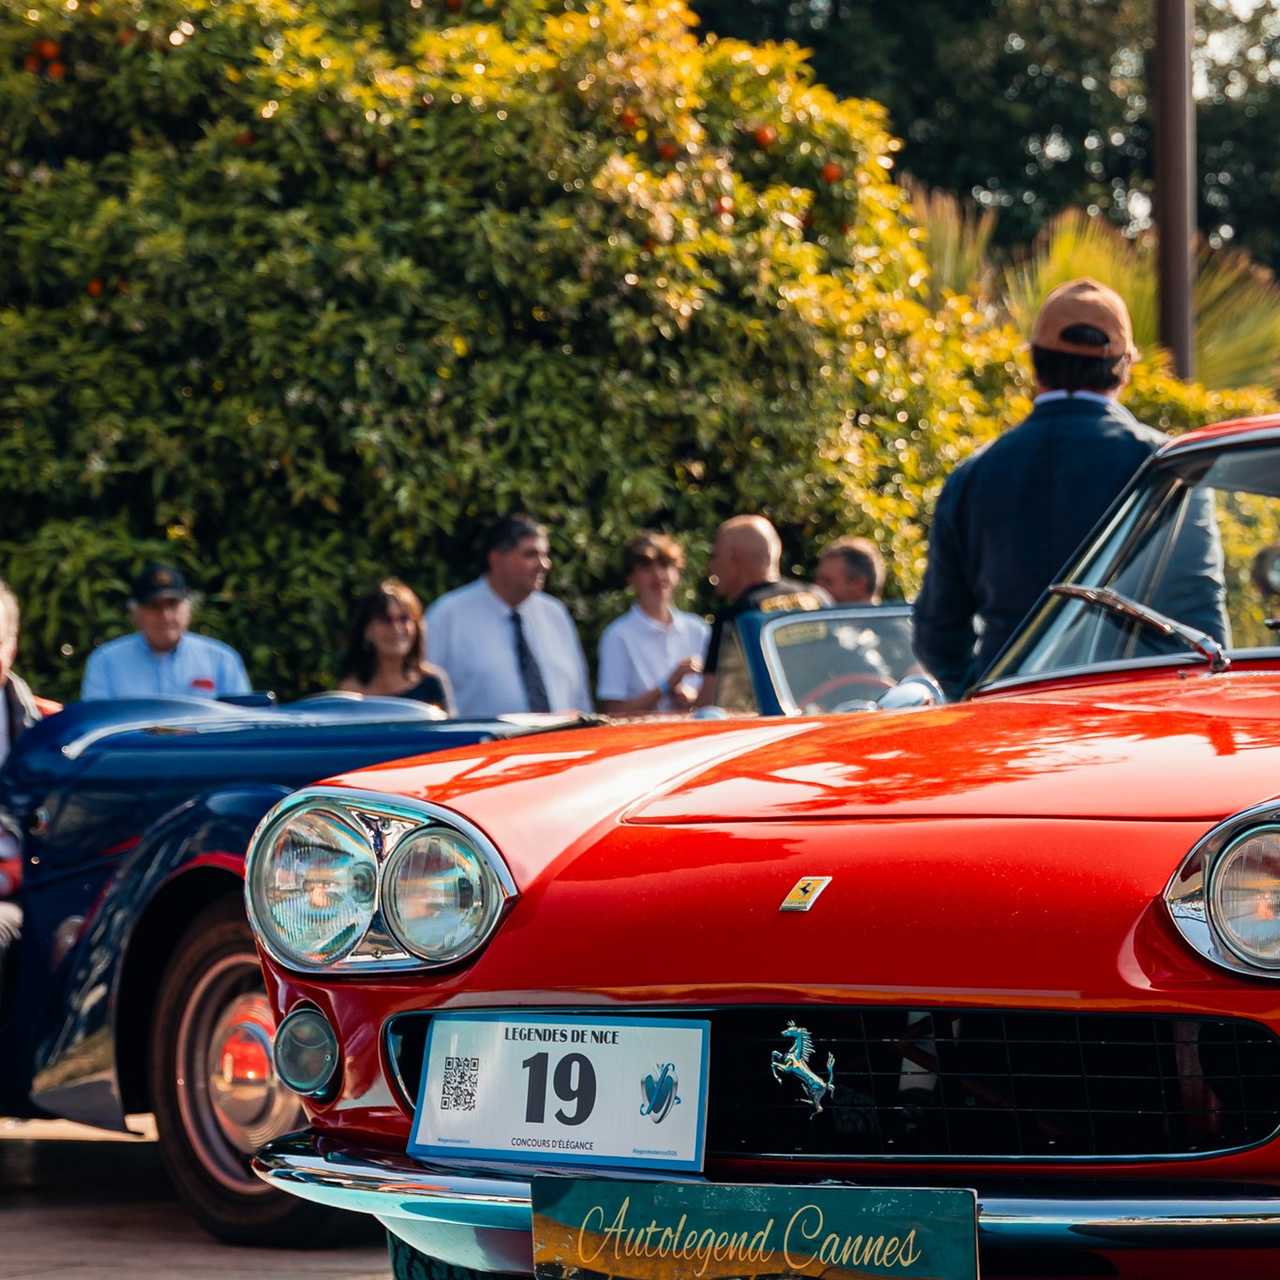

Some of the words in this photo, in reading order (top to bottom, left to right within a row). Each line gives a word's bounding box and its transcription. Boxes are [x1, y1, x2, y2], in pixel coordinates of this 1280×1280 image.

[504, 1027, 568, 1043] LEGENDES
[571, 1029, 588, 1043] DE
[590, 1030, 619, 1045] NICE
[522, 1052, 597, 1126] 19
[511, 1137, 551, 1148] CONCOURS
[551, 1138, 594, 1150] D'ÉLÉGANCE
[578, 1196, 775, 1277] Autolegend
[783, 1204, 922, 1269] Cannes
